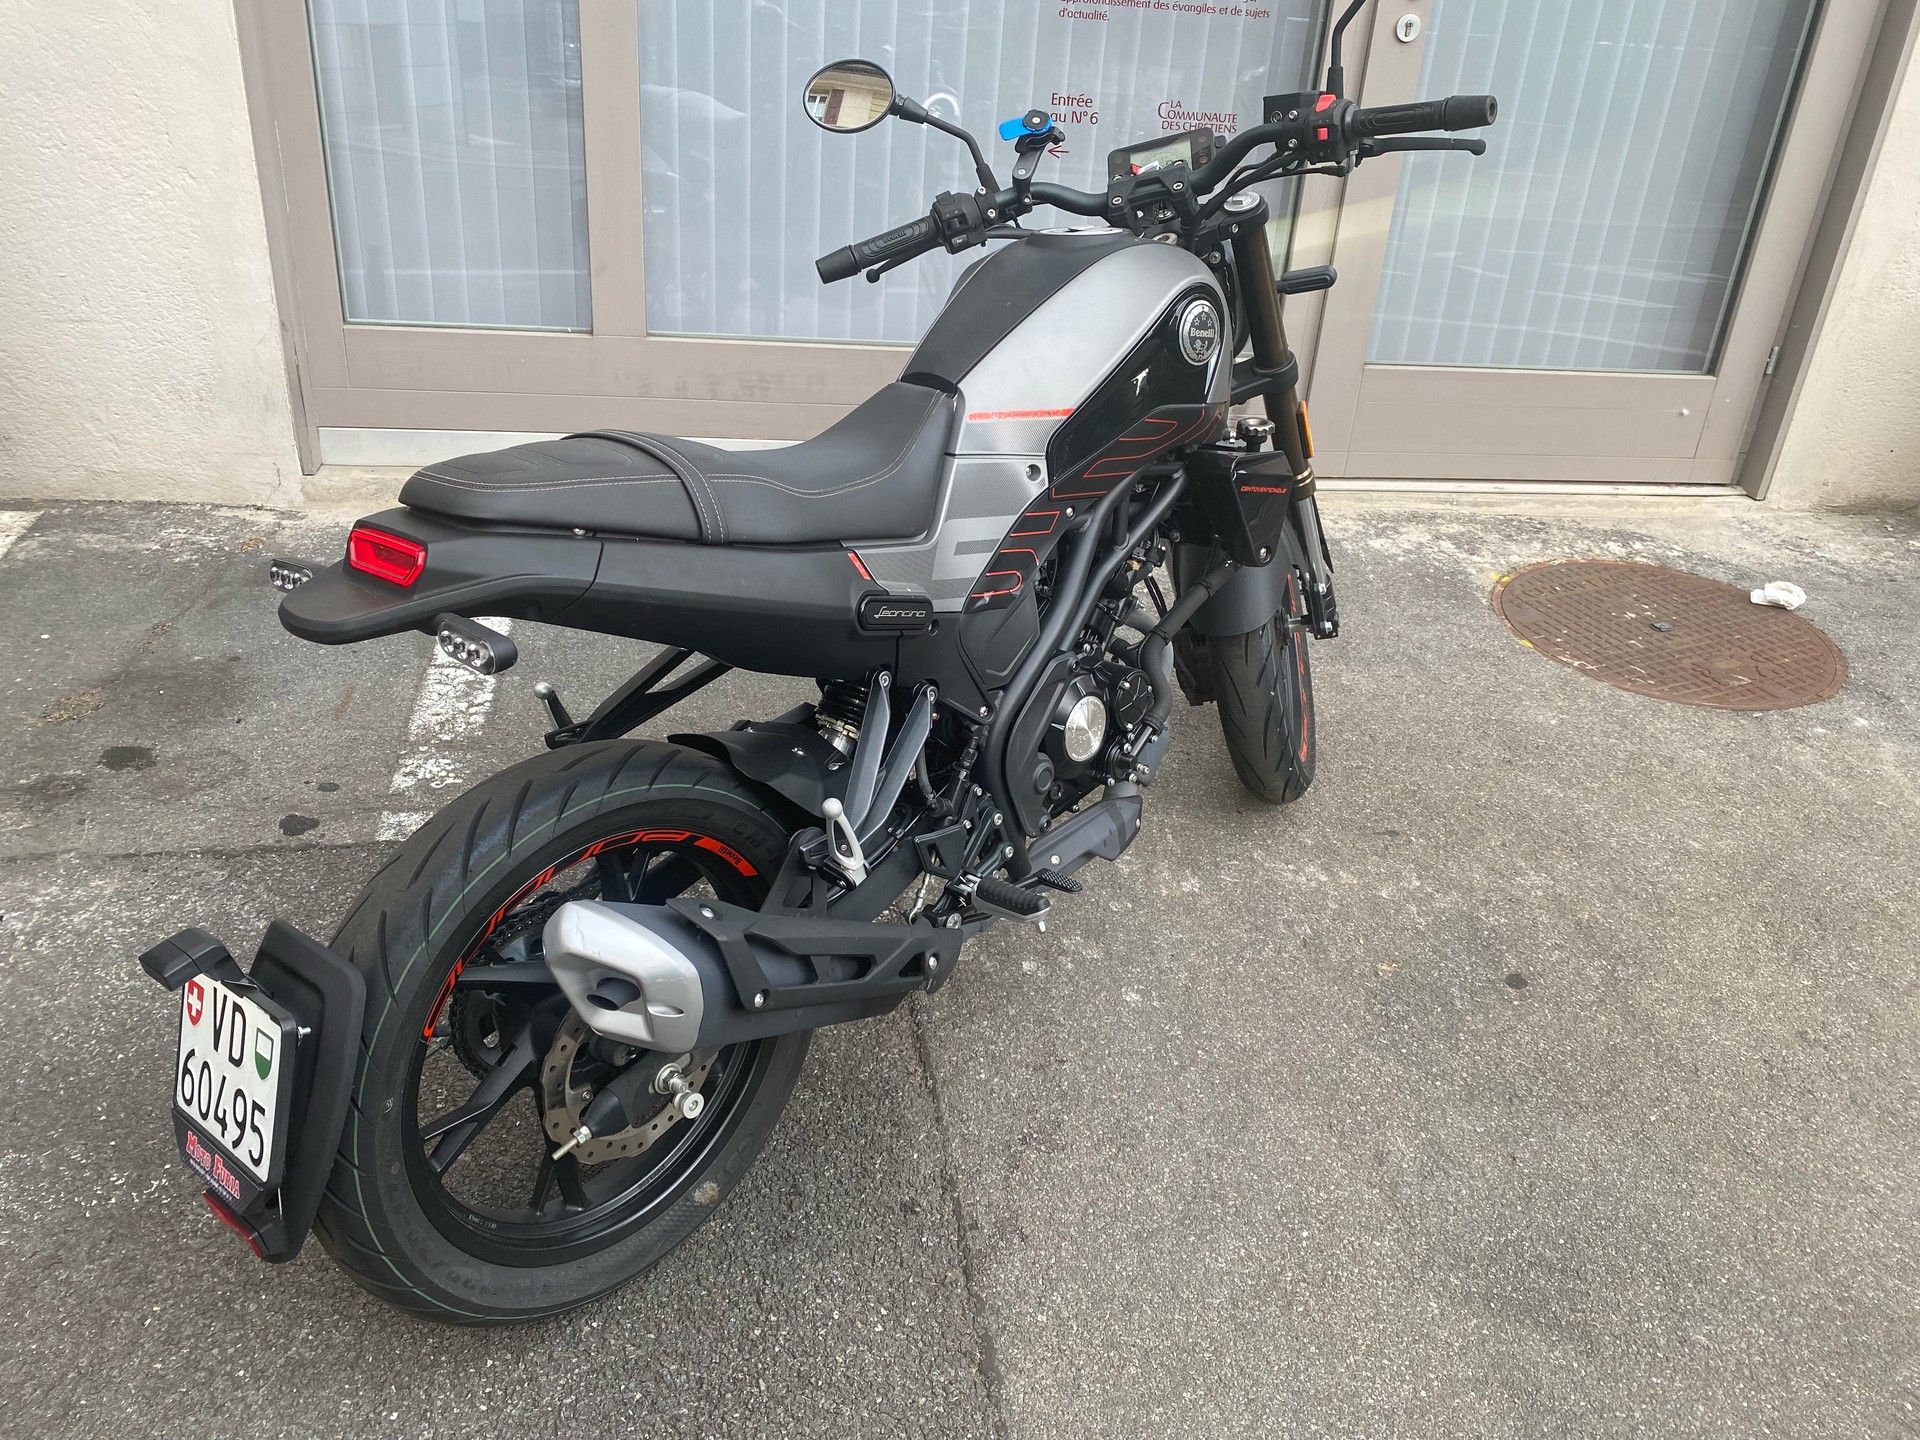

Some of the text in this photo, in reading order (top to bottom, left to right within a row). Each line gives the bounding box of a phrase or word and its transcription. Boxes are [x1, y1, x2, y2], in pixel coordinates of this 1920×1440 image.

[1058, 8, 1110, 21] d'actualité.
[1153, 1, 1170, 10] des
[1172, 1, 1216, 15] évangiles
[1219, 6, 1228, 15] et
[1231, 6, 1243, 16] de
[1245, 9, 1270, 19] sujets
[1051, 92, 1093, 108] Entrée
[1170, 99, 1182, 109] LA
[1051, 112, 1067, 123] au
[1090, 112, 1099, 125] 6
[1161, 120, 1181, 131] DES
[1190, 327, 1215, 338] Benelli
[717, 845, 743, 866] Benelli
[213, 986, 247, 1068] VD
[181, 1048, 266, 1168] 60495
